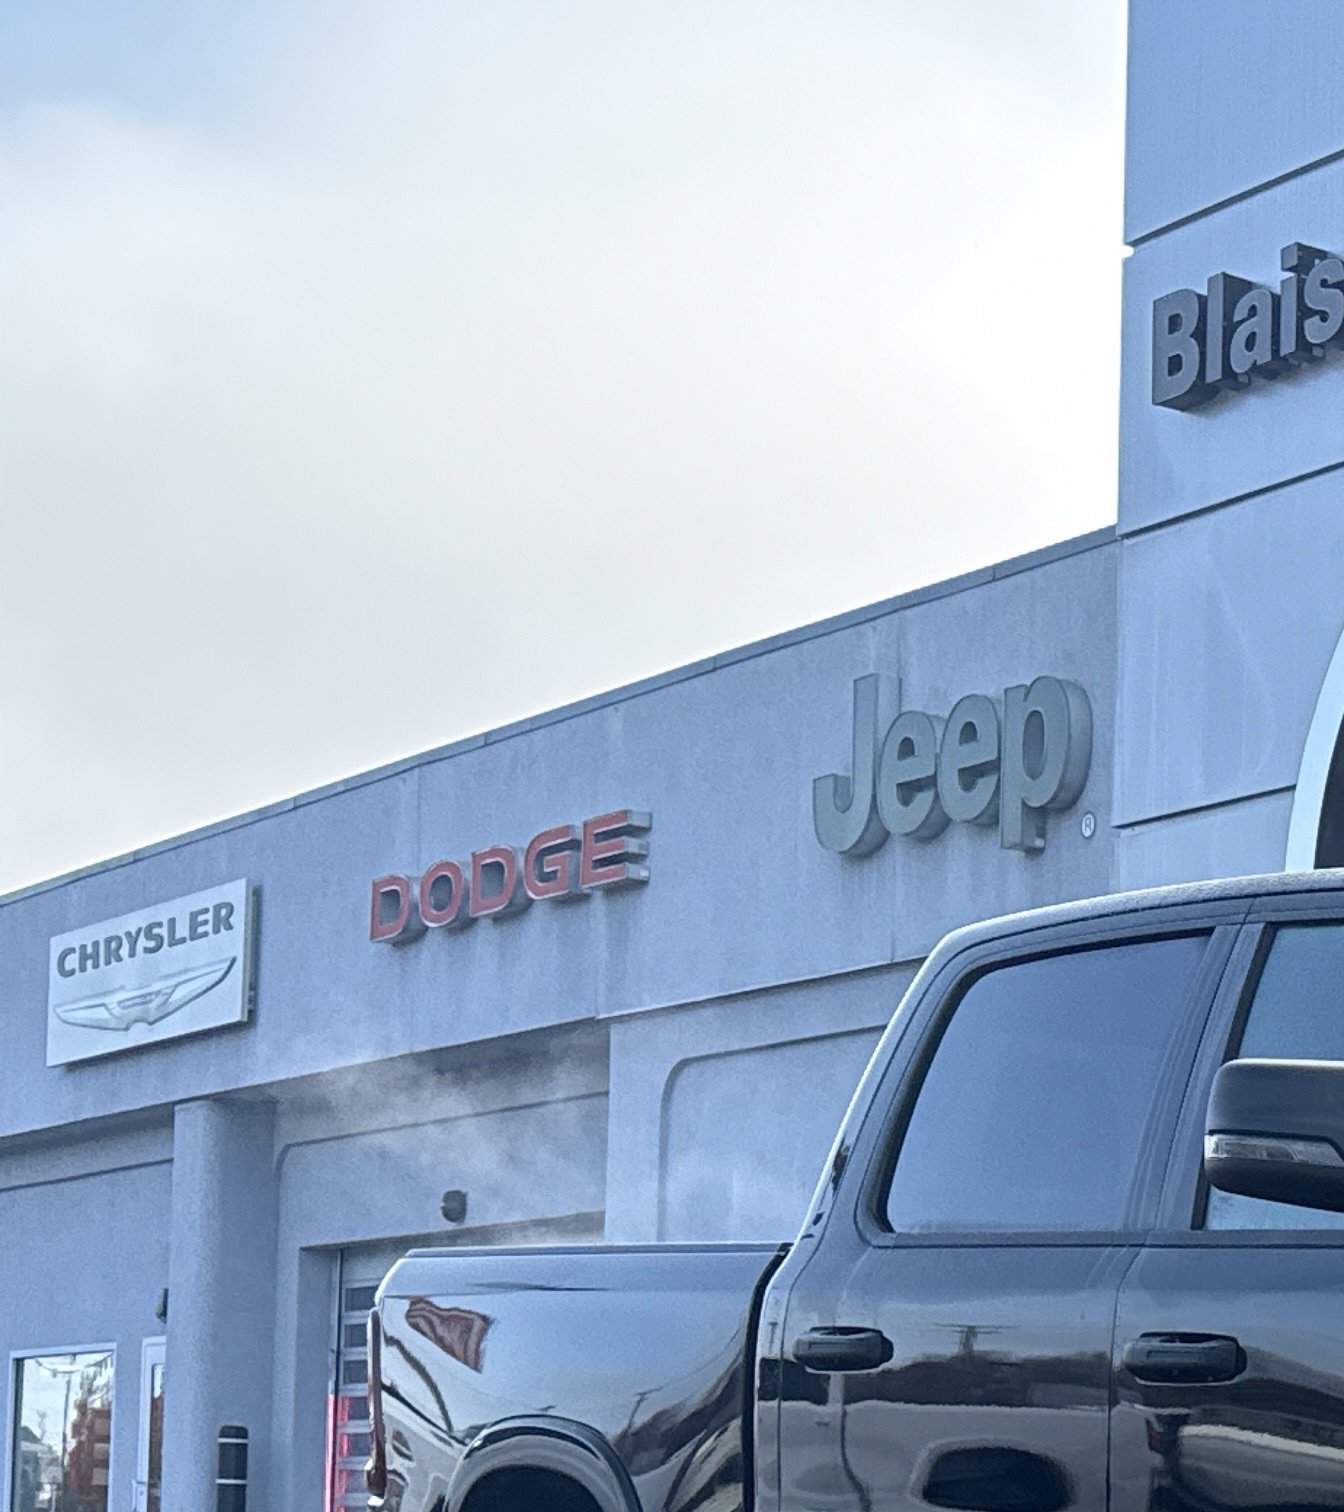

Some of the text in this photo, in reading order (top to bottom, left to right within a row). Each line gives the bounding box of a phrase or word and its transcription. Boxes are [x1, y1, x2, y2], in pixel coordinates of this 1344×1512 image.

[812, 672, 1092, 857] Jeep
[57, 901, 235, 978] CHRYSLER
[369, 808, 652, 944] DODGE
